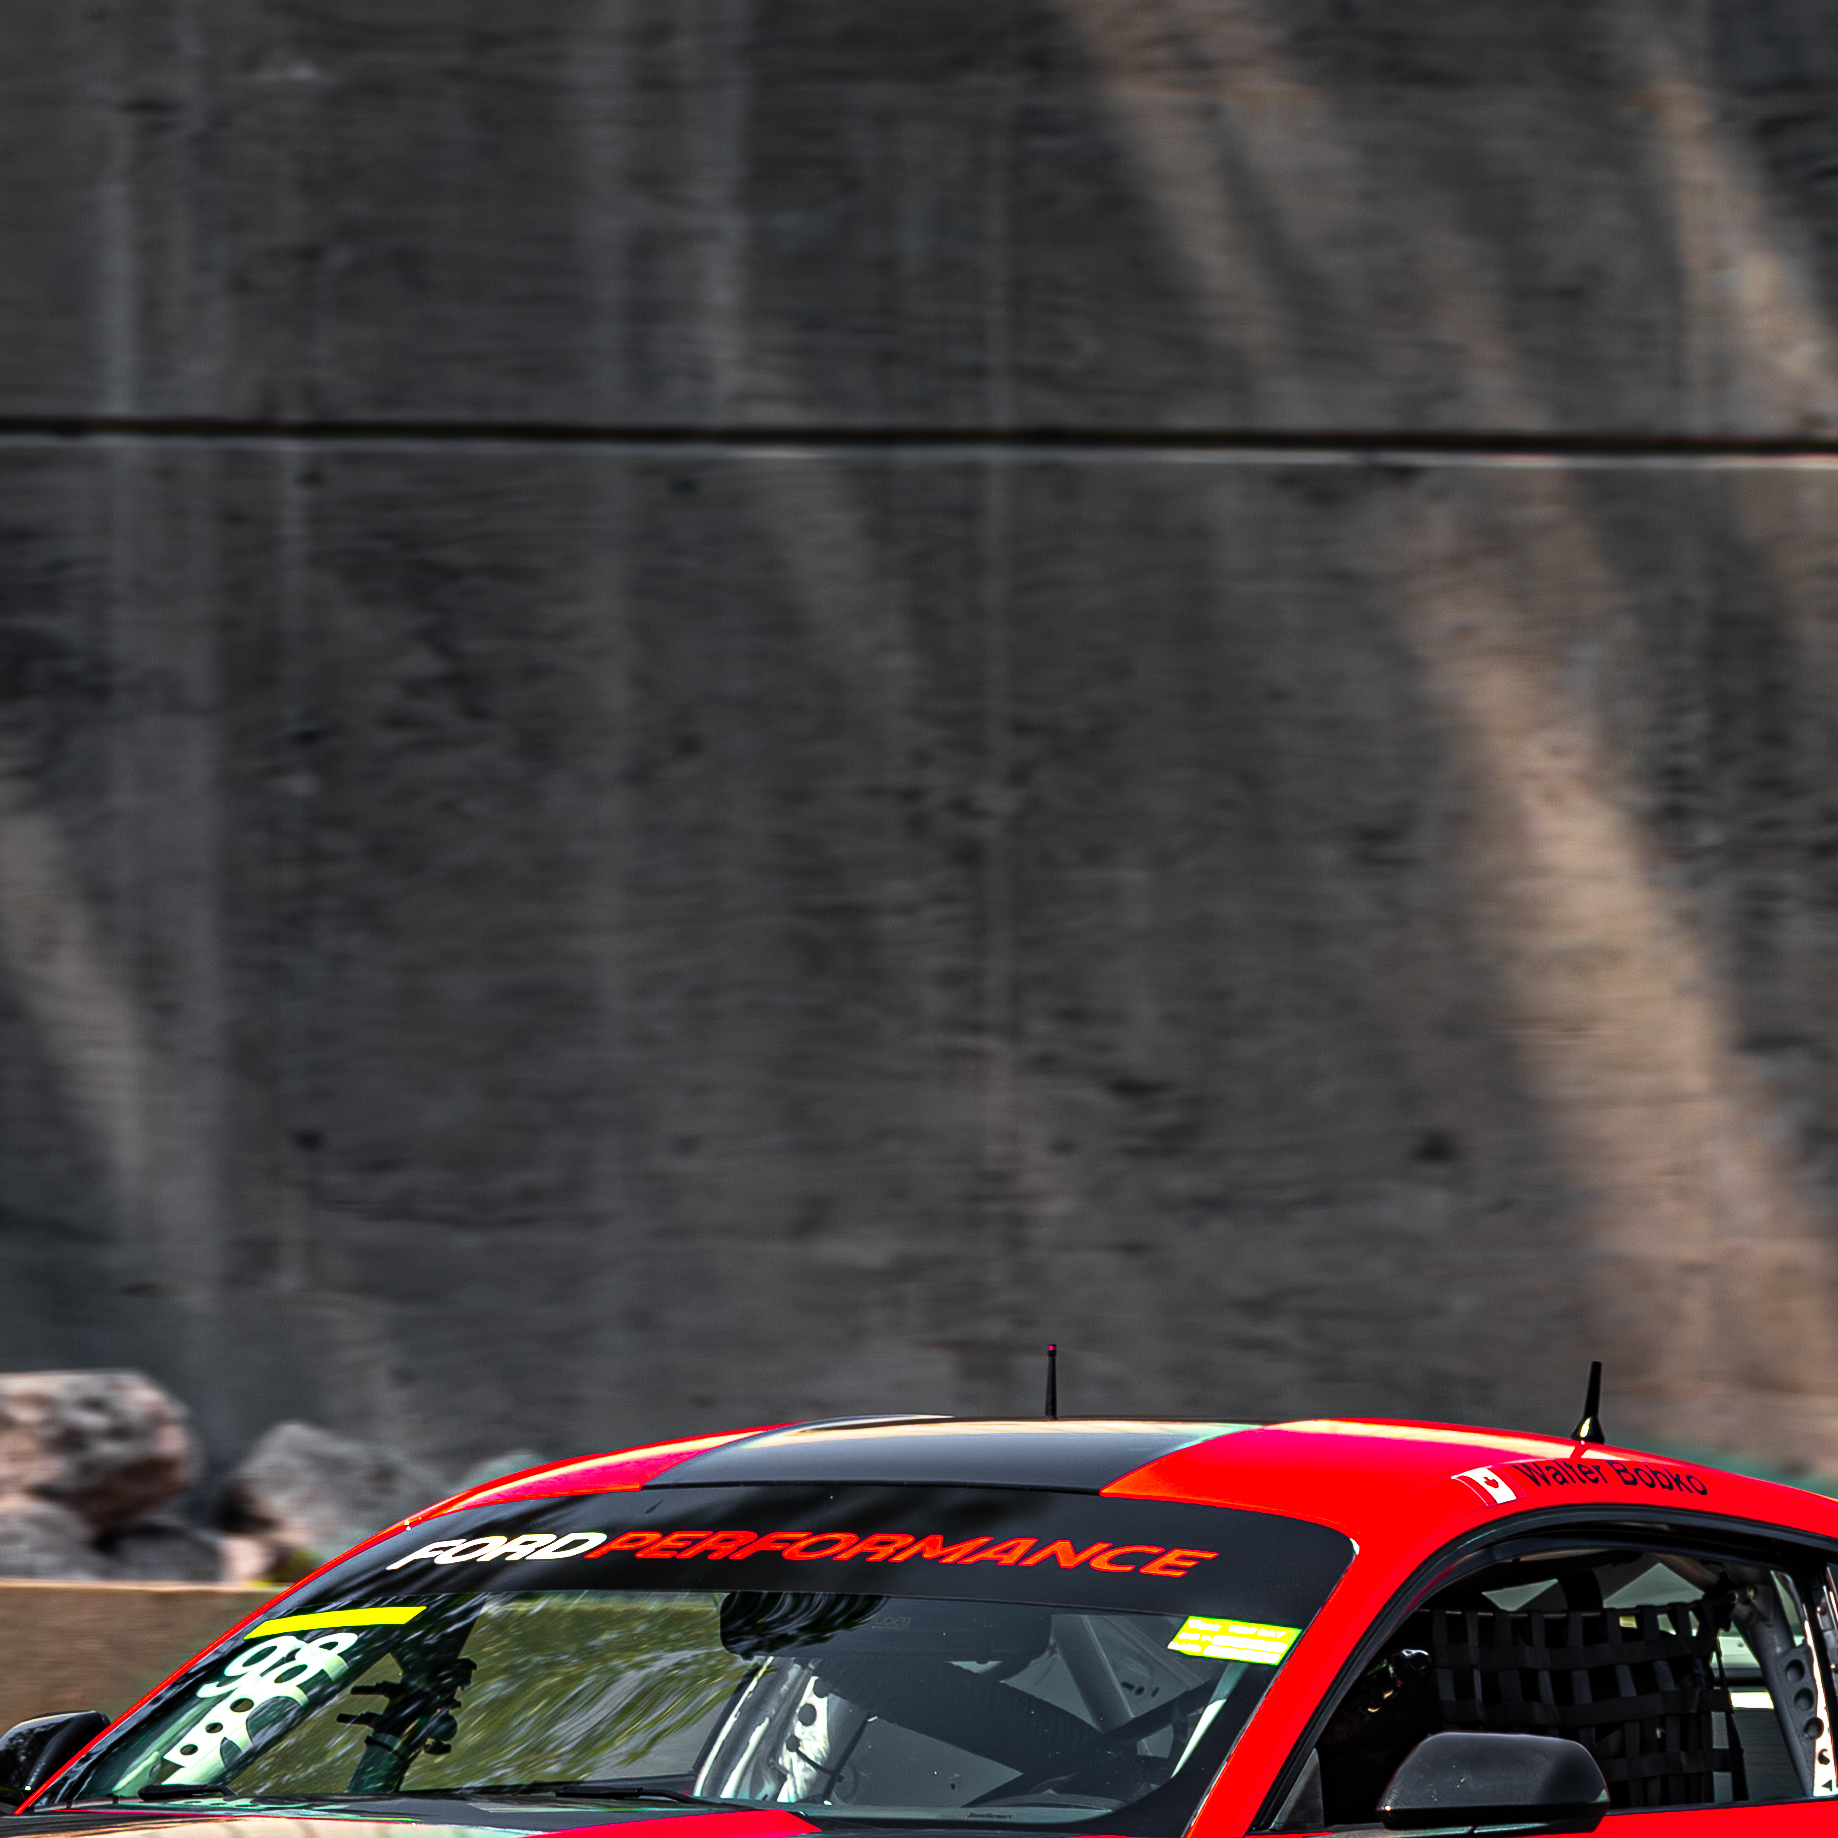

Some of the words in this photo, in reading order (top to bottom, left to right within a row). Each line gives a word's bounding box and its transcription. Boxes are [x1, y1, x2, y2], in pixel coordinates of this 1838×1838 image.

[1511, 1458, 1609, 1488] Walter
[1604, 1459, 1708, 1496] Bobko
[196, 1632, 359, 1699] 98
